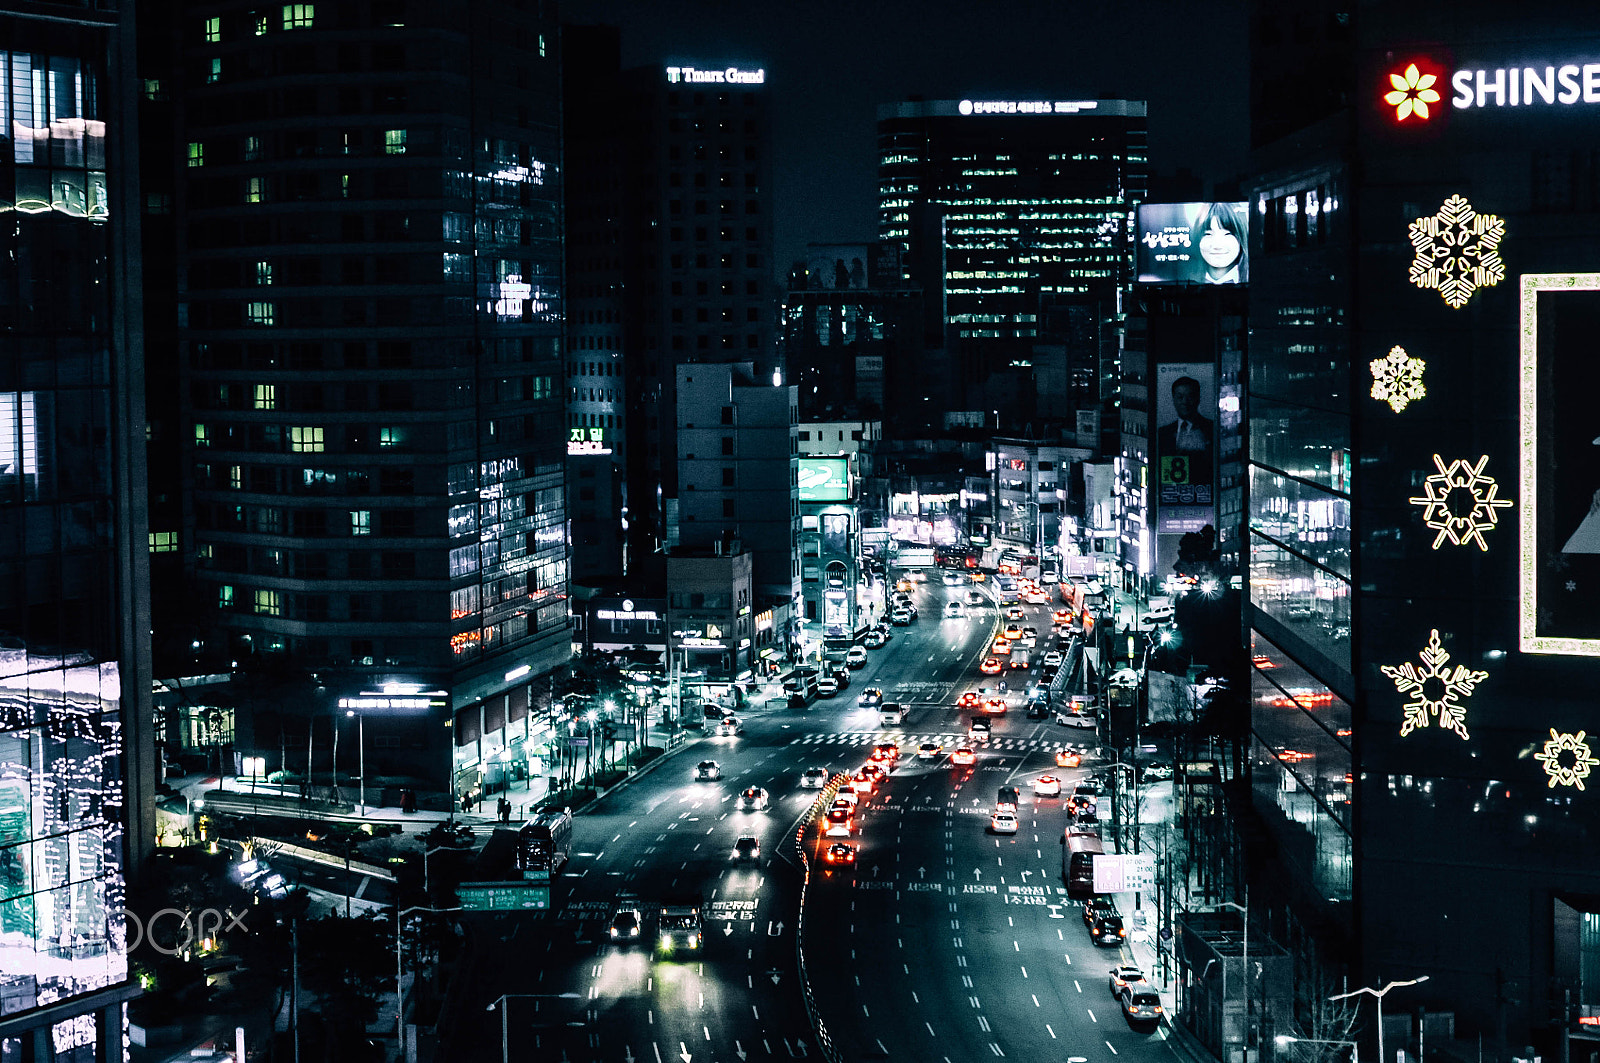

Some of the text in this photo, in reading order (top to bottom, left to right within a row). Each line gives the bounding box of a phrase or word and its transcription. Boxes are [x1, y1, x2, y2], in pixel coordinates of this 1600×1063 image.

[1452, 64, 1600, 109] SHINSE
[1170, 457, 1187, 483] 8
[1010, 895, 1047, 906] 주차장
